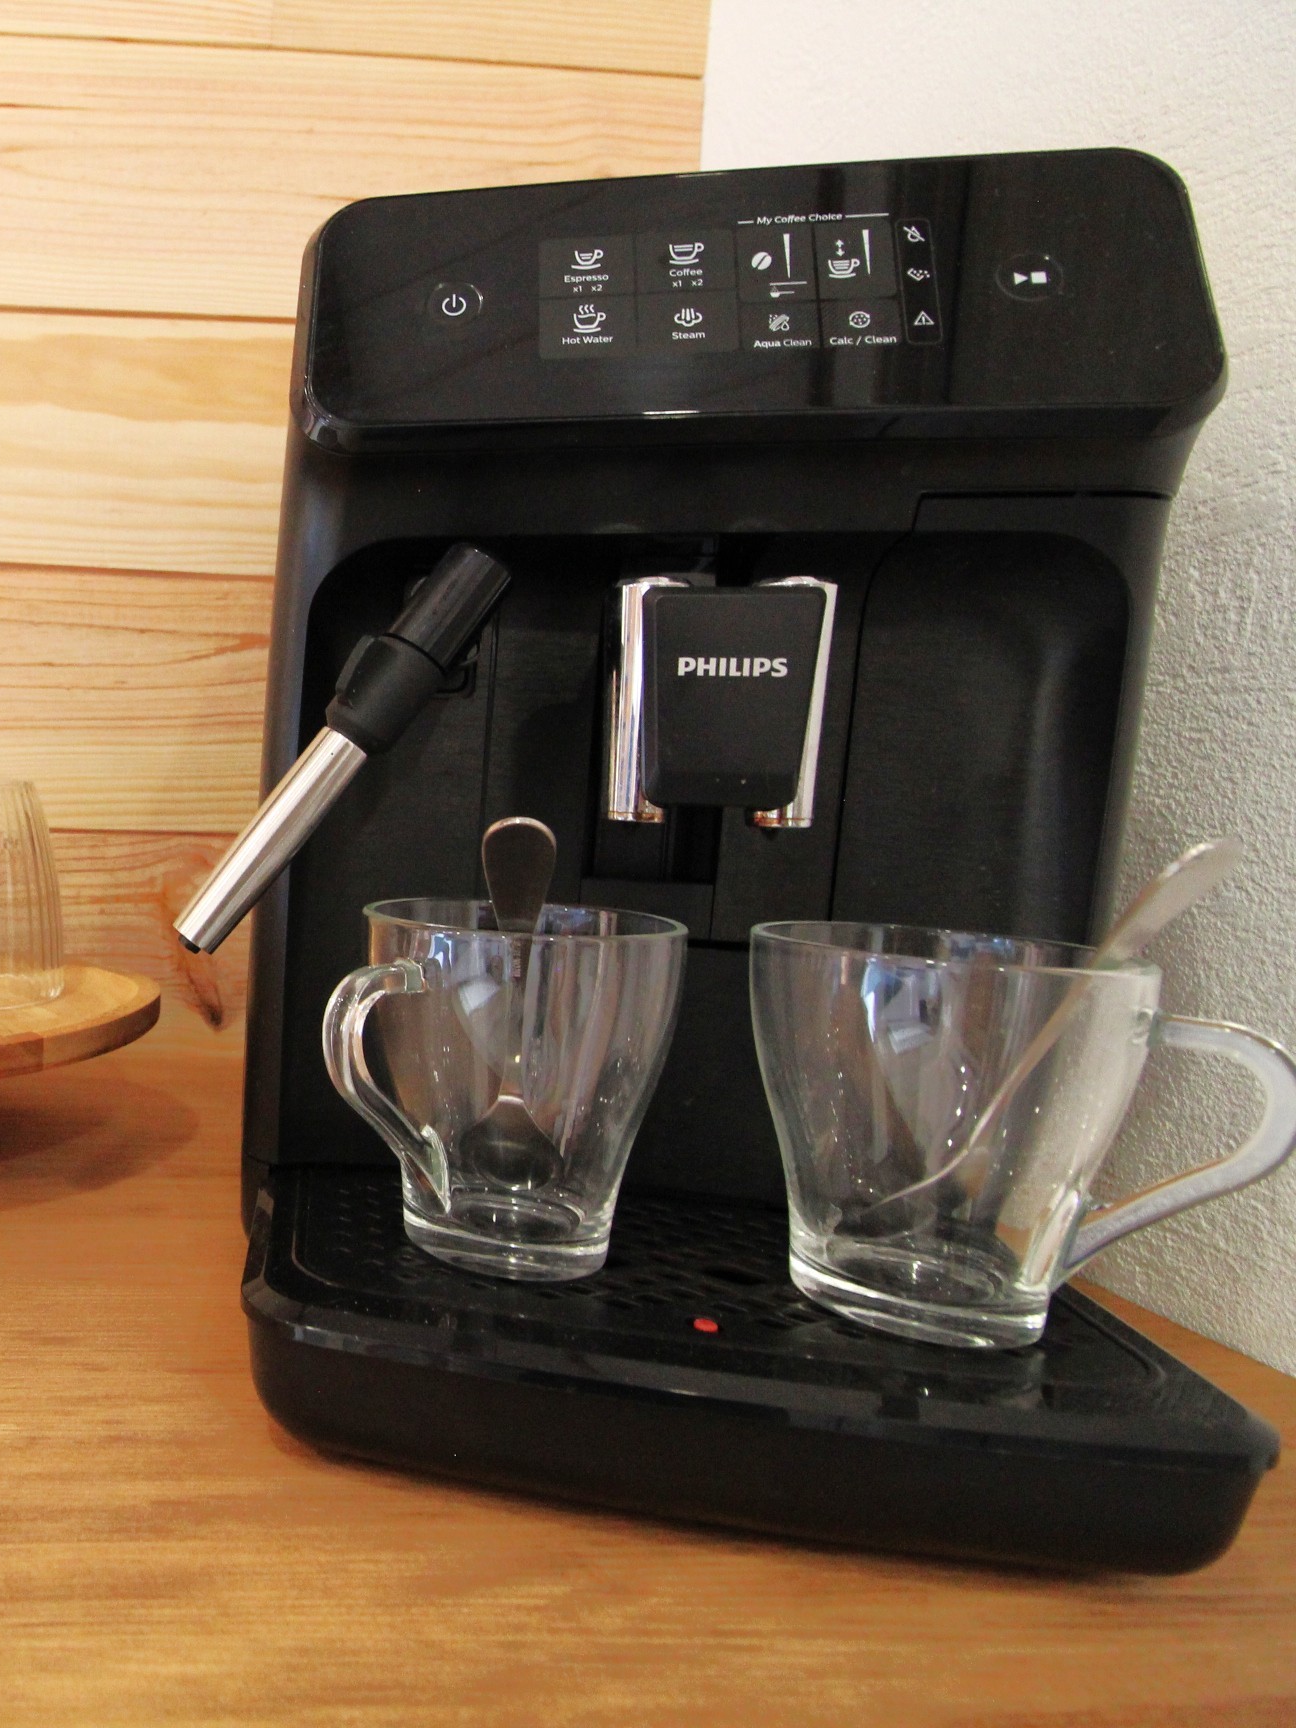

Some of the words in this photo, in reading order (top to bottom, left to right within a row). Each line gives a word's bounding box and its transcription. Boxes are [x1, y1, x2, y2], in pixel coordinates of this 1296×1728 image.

[756, 217, 773, 226] My
[774, 214, 806, 224] Coffee
[808, 212, 843, 222] Choice
[669, 268, 703, 277] Coffee
[564, 273, 609, 284] Espresso
[691, 278, 703, 287] x2
[572, 285, 582, 293] x1
[591, 284, 603, 292] x2
[562, 337, 580, 345] Hot
[582, 335, 613, 344] Water
[672, 331, 706, 340] Steam
[829, 336, 853, 346] Calc
[864, 334, 897, 344] Clean
[753, 339, 781, 349] Aqua
[783, 338, 812, 347] Clean
[677, 657, 788, 678] PHILIPS
